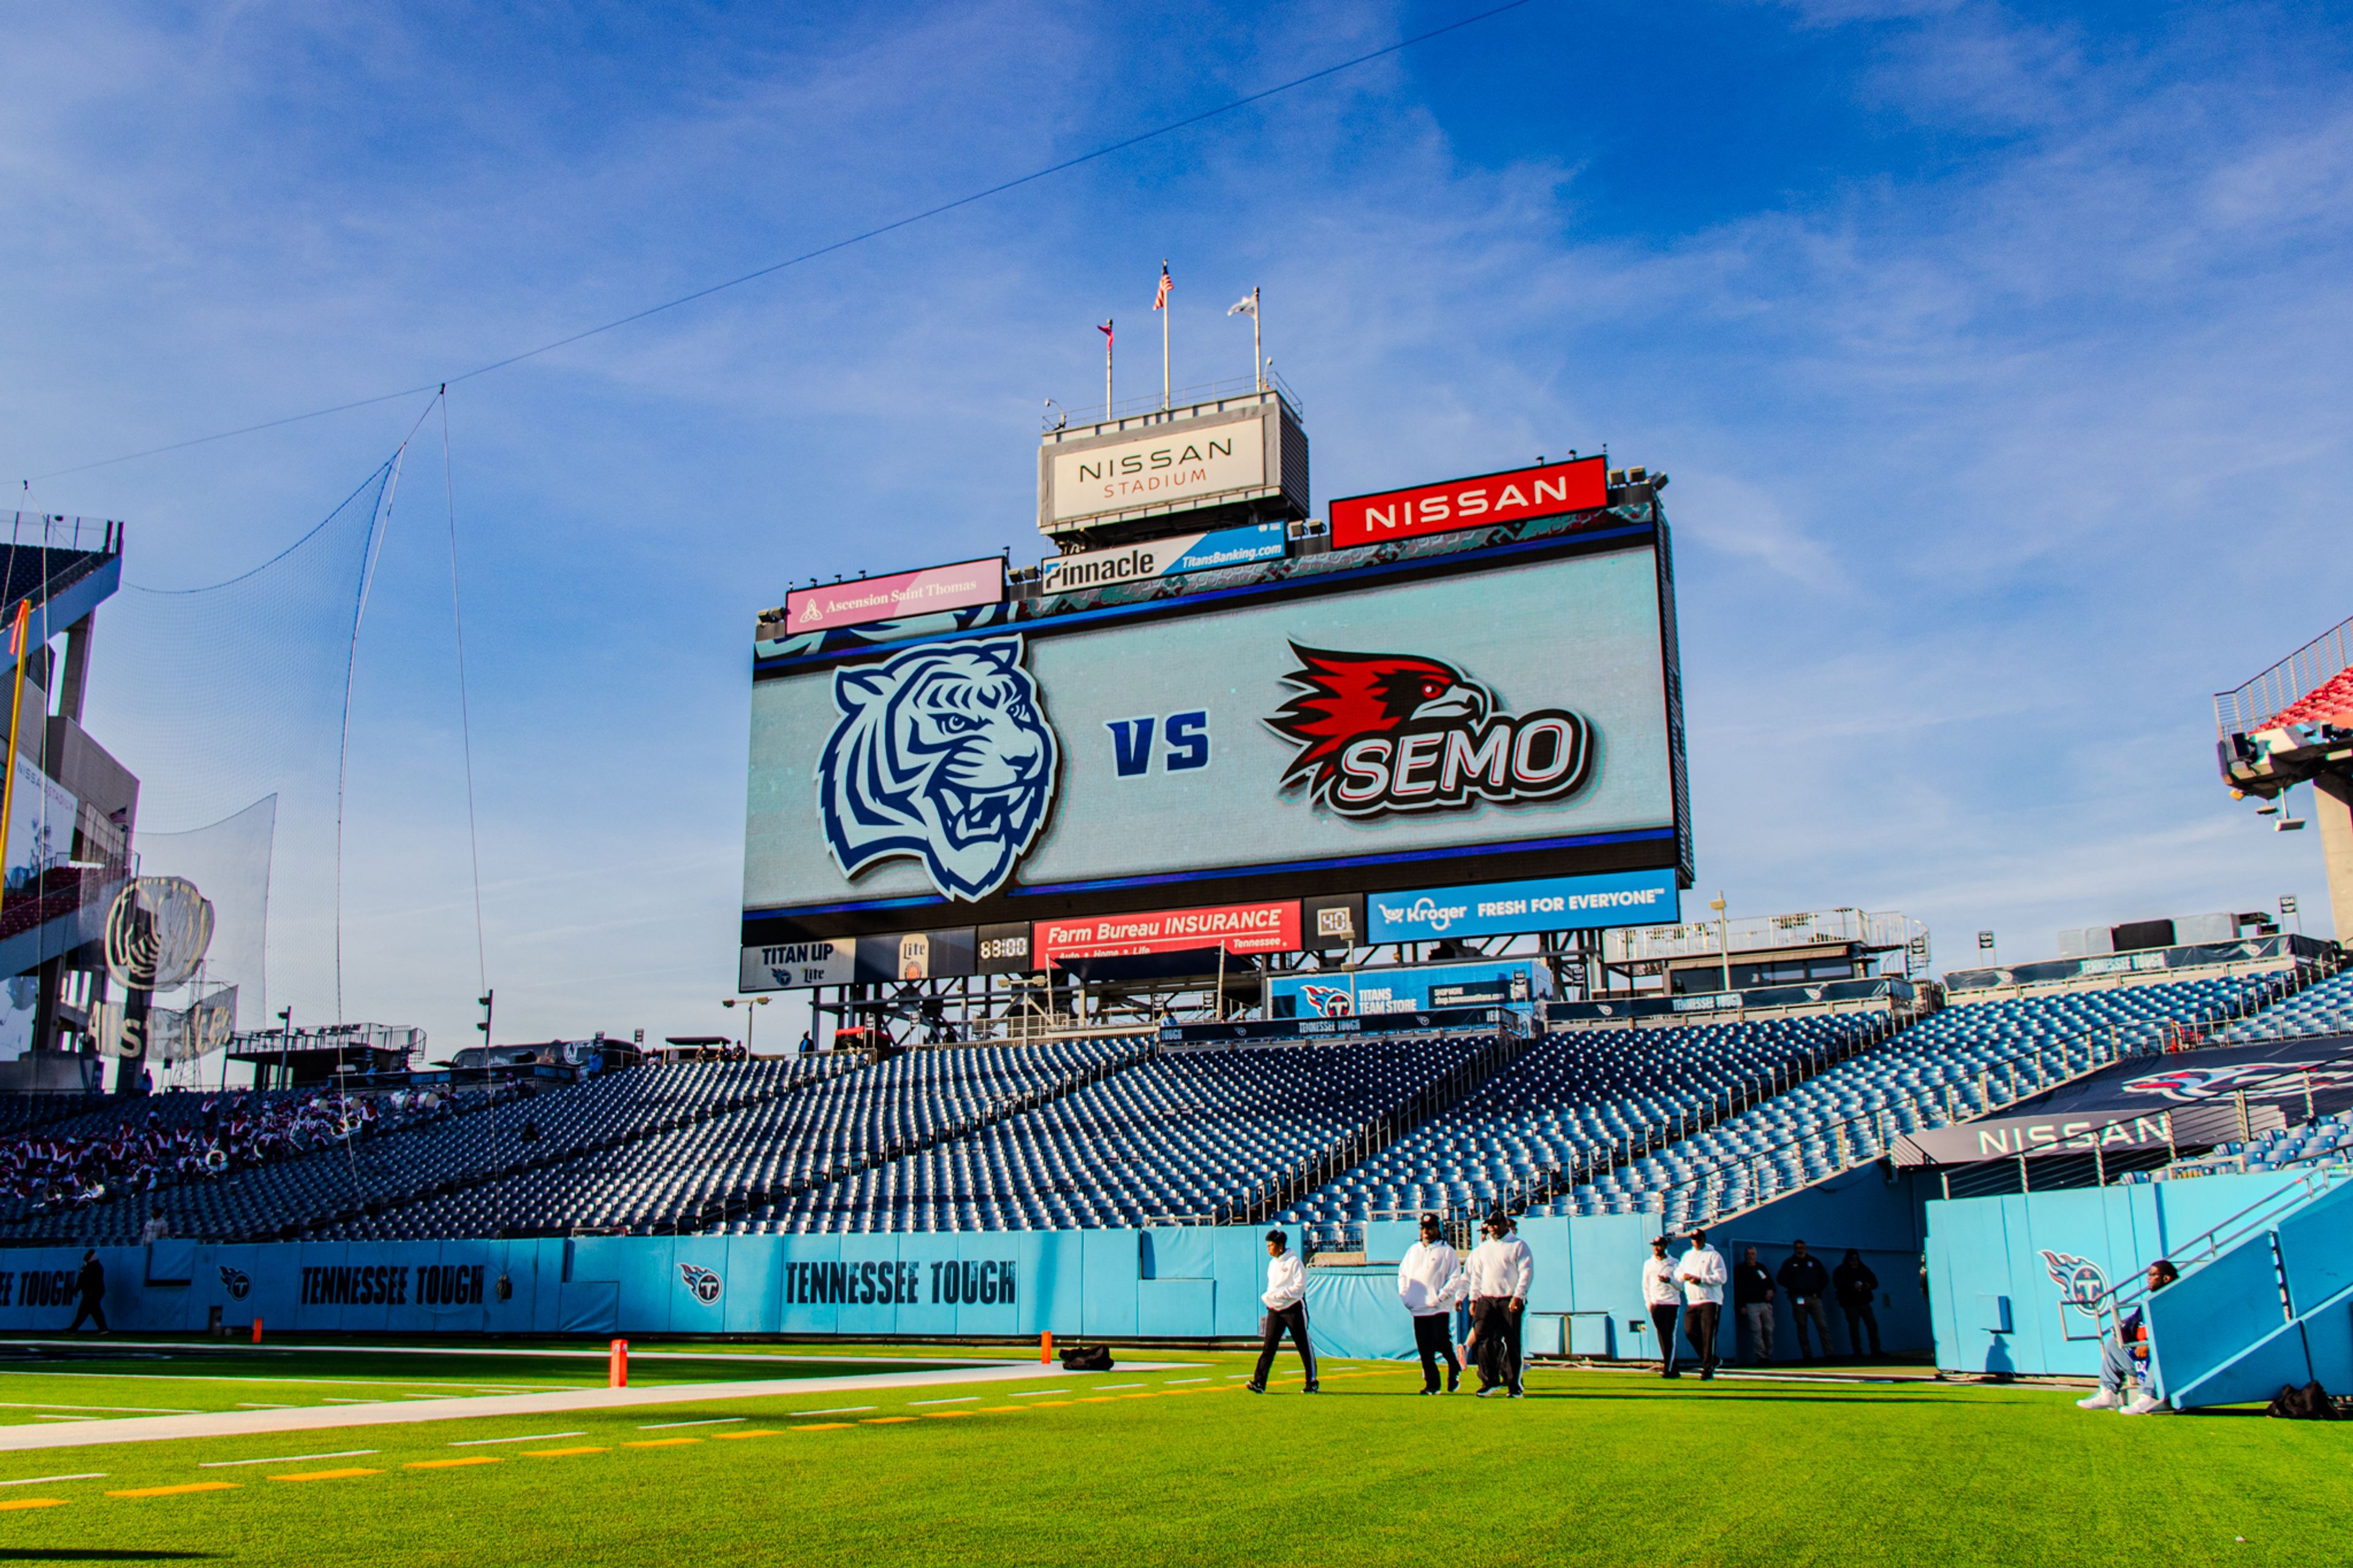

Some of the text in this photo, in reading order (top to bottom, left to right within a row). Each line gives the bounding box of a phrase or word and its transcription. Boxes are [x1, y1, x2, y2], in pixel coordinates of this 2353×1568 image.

[1080, 438, 1231, 482] NISSAN
[1104, 468, 1207, 498] STADIUM
[1365, 476, 1566, 532] NISSAN
[1045, 550, 1154, 589] Pinnacle
[1183, 543, 1282, 569] TitansBanking.com
[826, 578, 977, 613] Ascension Saint Thomas
[1105, 709, 1210, 778] VS
[1338, 717, 1574, 801] SEMO
[1322, 912, 1346, 930] 40
[1407, 897, 1468, 931] Kroger
[1477, 900, 1526, 917] FRESH
[1531, 896, 1566, 912] FOR
[1048, 908, 1282, 944] Farm Bureau INSURANCE
[1233, 937, 1281, 949] Tennessee
[762, 942, 834, 965] TITAN UP
[903, 942, 926, 960] Lite
[1132, 945, 1151, 955] Life
[804, 966, 825, 983] Lite
[1358, 988, 1392, 1002] TITANS
[1359, 999, 1417, 1014] TEAM STORE
[1977, 1115, 2172, 1155] NISSAN
[18, 1270, 76, 1307] TOUGH
[301, 1264, 485, 1305] TENNESSEE TOUGH
[786, 1260, 1016, 1305] TENNESSEE TOUGH
